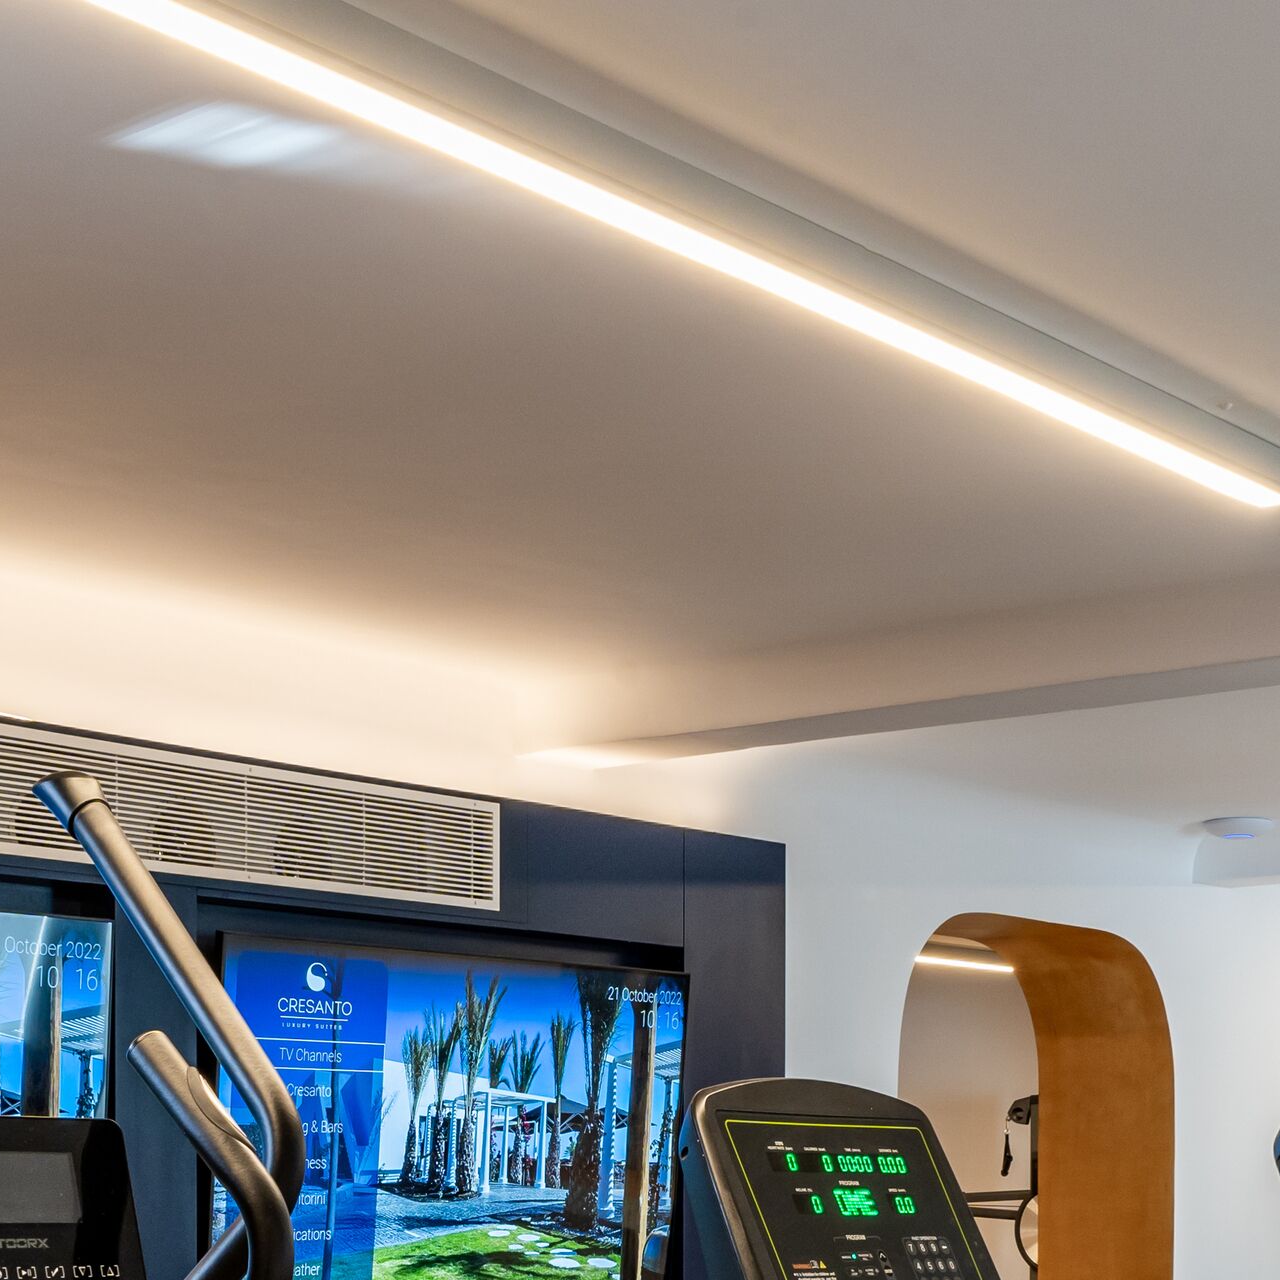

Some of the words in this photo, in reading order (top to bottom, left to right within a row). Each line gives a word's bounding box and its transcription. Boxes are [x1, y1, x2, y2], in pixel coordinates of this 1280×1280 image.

[5, 936, 62, 956] October
[66, 941, 101, 960] 2022
[36, 965, 58, 988] 10
[76, 968, 98, 991] 16
[608, 986, 619, 1000] 21
[622, 987, 657, 1003] October
[660, 990, 682, 1005] 2022
[277, 997, 353, 1016] CRESANTO
[280, 1047, 294, 1061] TV
[296, 1048, 342, 1063] Channels
[287, 1083, 332, 1097] Cresanto
[321, 1121, 344, 1133] Bars
[786, 1153, 798, 1171] 0
[821, 1155, 834, 1172] 0
[811, 1196, 823, 1213] 0
[293, 1228, 332, 1241] ications
